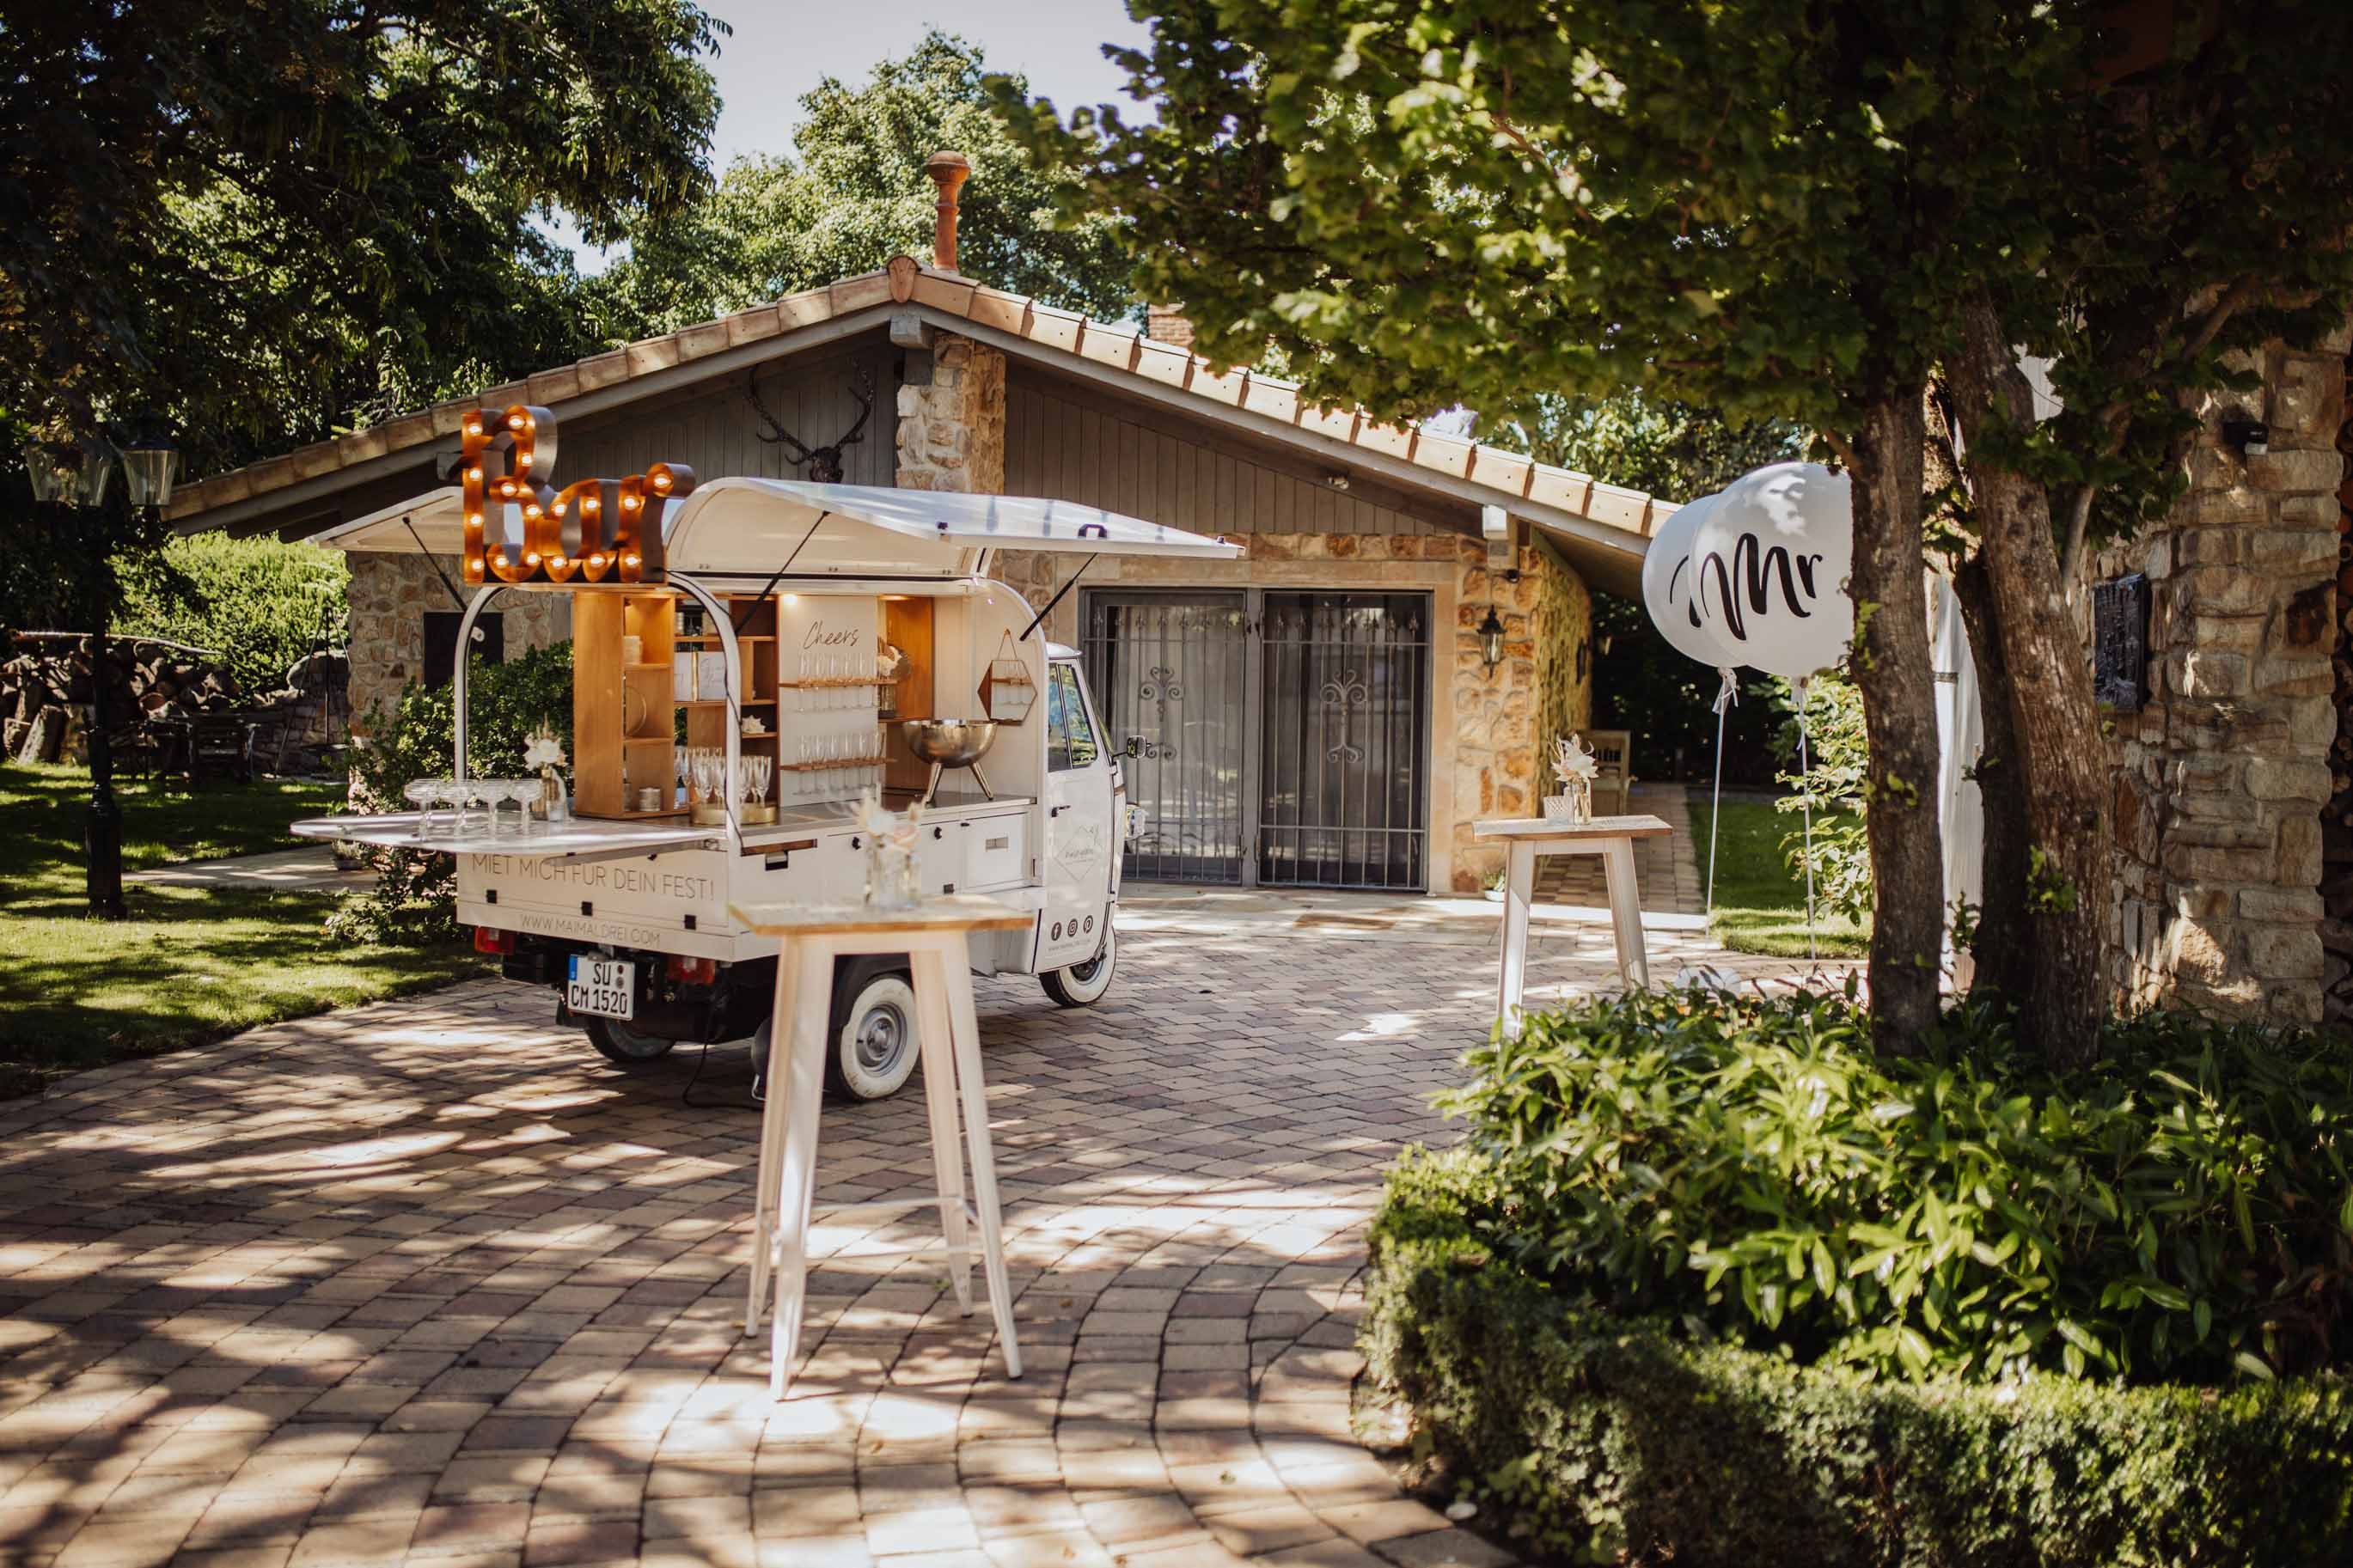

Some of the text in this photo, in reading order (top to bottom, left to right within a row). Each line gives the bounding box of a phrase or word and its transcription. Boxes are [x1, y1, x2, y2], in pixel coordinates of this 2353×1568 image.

[461, 405, 694, 583] Bar
[1700, 532, 1824, 641] Mr
[803, 619, 859, 650] Cheers
[471, 852, 511, 876] MIET
[518, 857, 567, 883] MICH
[614, 867, 656, 894] DEIN
[662, 873, 715, 901] FEST!
[593, 962, 611, 986] SU
[571, 984, 628, 1015] CM 1520
